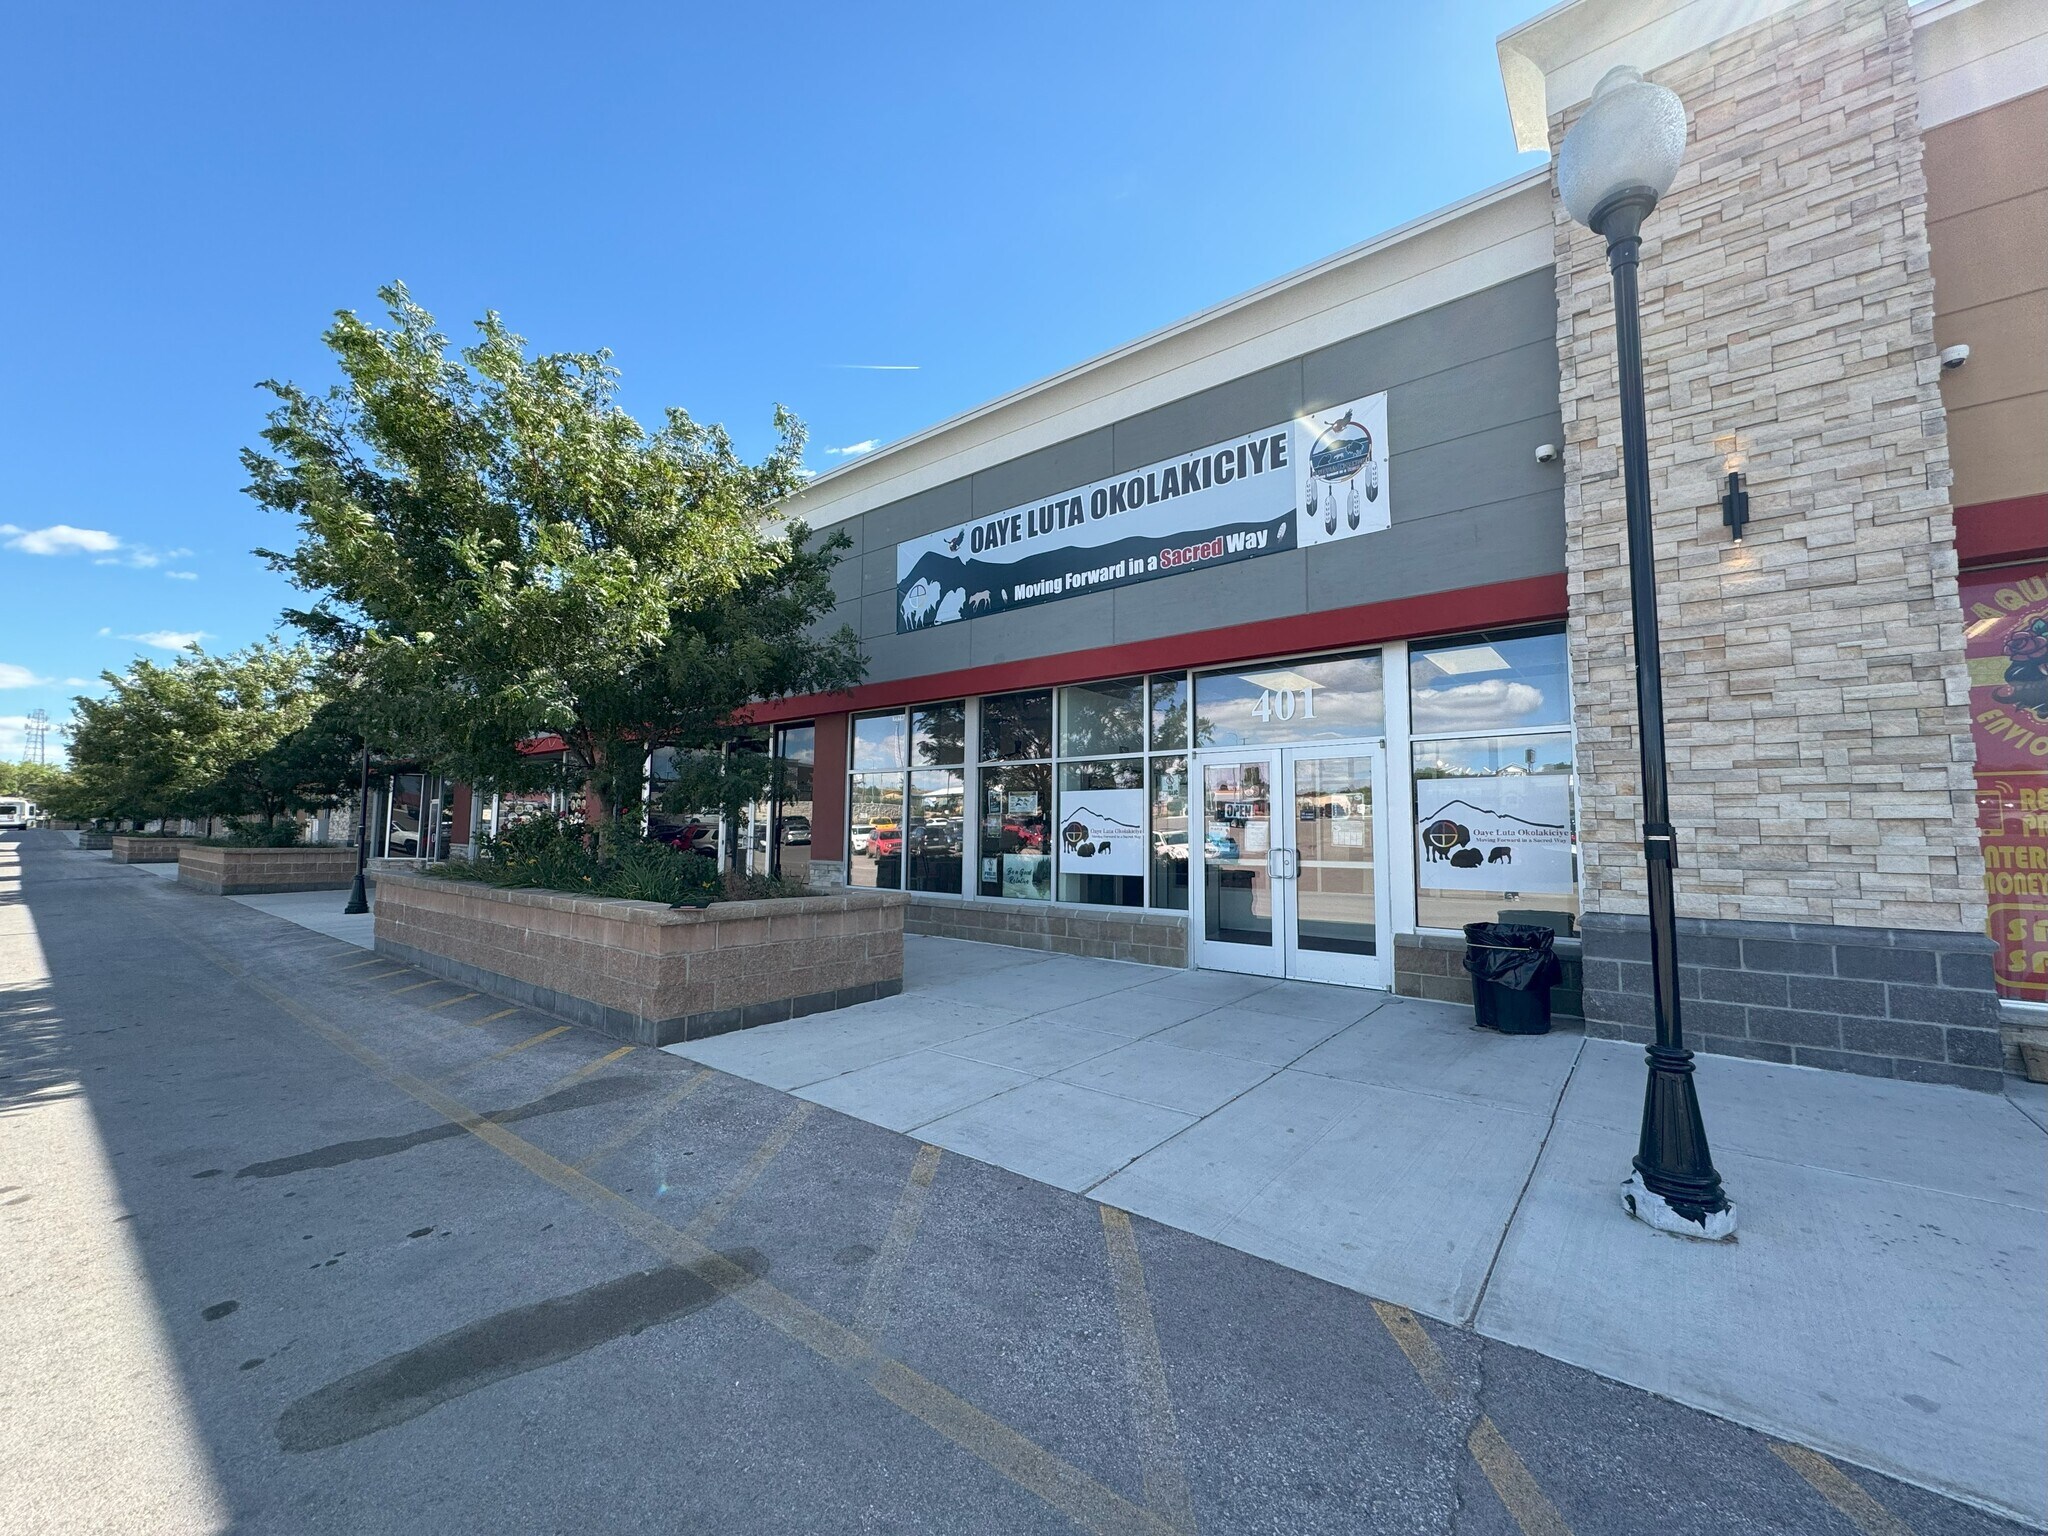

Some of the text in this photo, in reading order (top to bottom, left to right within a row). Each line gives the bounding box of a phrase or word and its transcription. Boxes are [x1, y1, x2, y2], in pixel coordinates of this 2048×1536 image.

[970, 432, 1288, 553] OAYE LUTA OKOLAKICIYE
[1014, 529, 1268, 601] Moving Forward in a Sacred Way
[1970, 574, 2048, 620] AQU
[1251, 685, 1319, 723] 401
[1226, 804, 1252, 817] OPEN
[1473, 828, 1494, 837] Oaye
[1518, 828, 1569, 837] Okolakiciye
[1984, 844, 2048, 869] NTER
